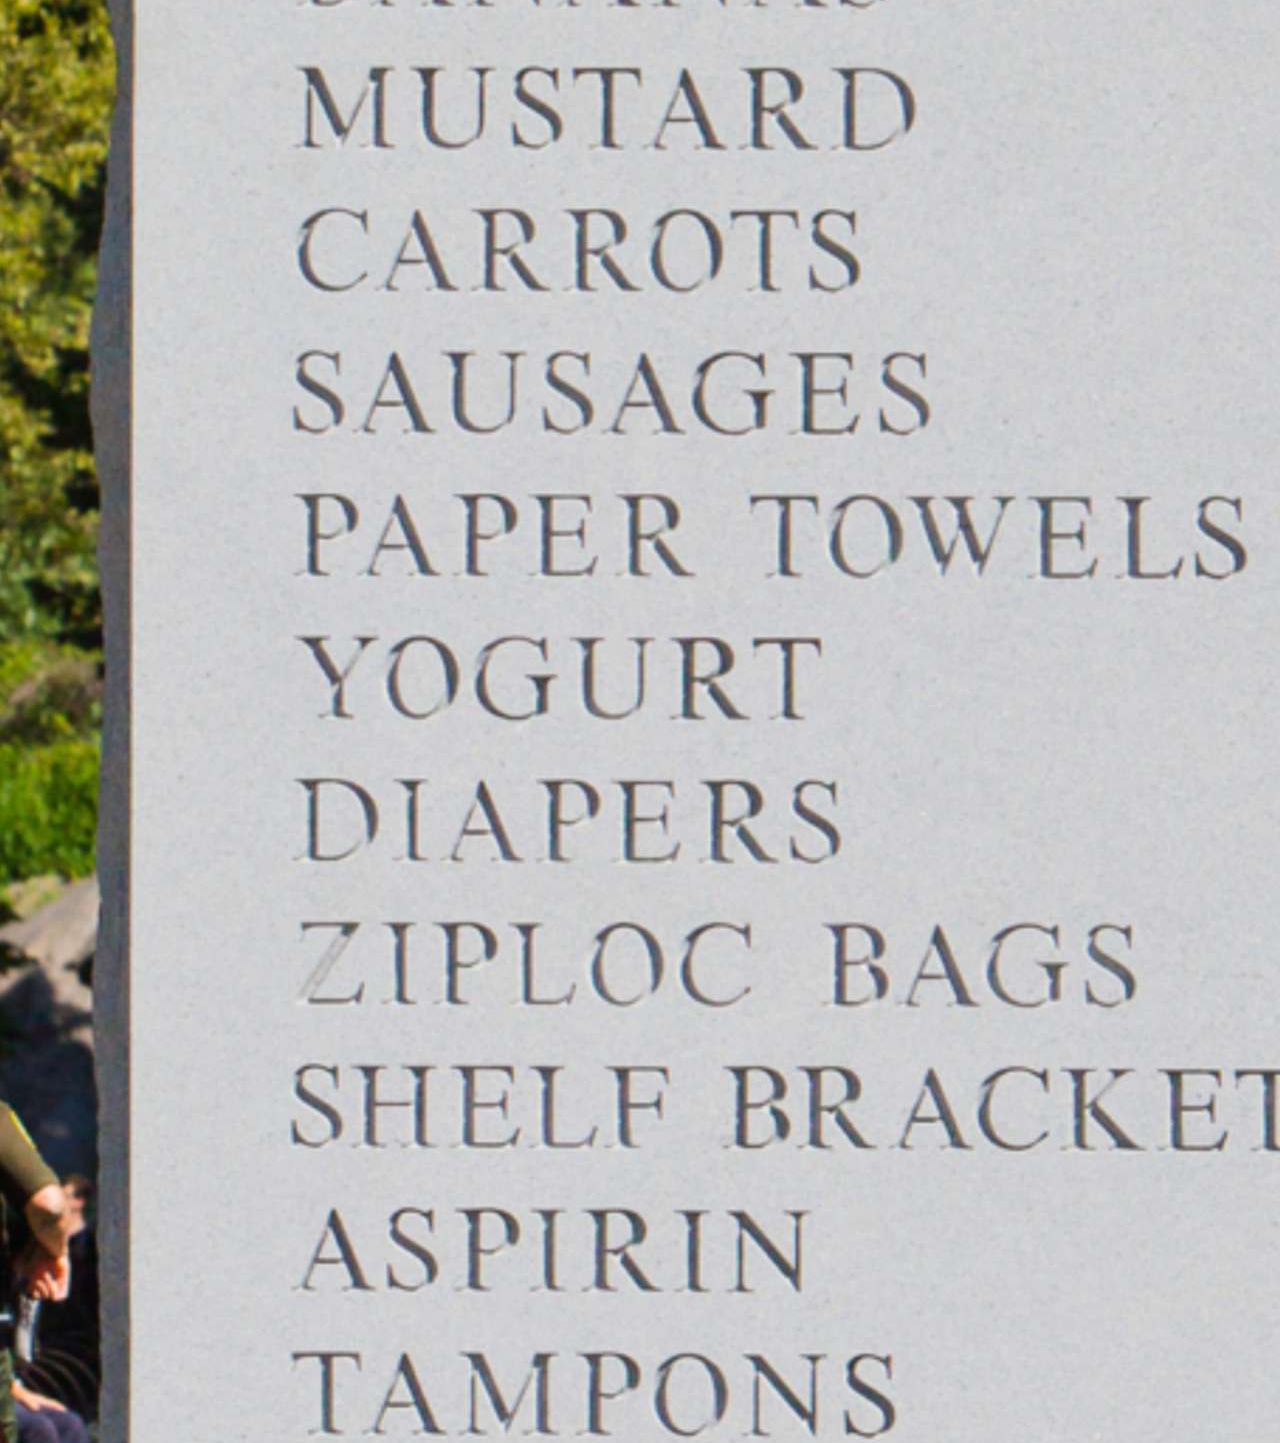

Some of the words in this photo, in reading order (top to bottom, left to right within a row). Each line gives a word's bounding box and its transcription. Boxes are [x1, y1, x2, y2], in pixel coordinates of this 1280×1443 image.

[295, 65, 917, 152] MUSTARD
[297, 207, 861, 294] CARROTS
[292, 349, 931, 437] SAUSAGES
[294, 492, 696, 578] PAPER
[748, 493, 1248, 581] TOWELS
[295, 634, 823, 722] YOGURT
[294, 777, 842, 865] DIAPERS
[300, 920, 752, 1008] ZIPLOC
[823, 922, 1137, 1010] BAGS
[290, 1062, 670, 1149] SHELF
[300, 1206, 810, 1294] ASPIRIN
[290, 1350, 897, 1439] TAMPONS
